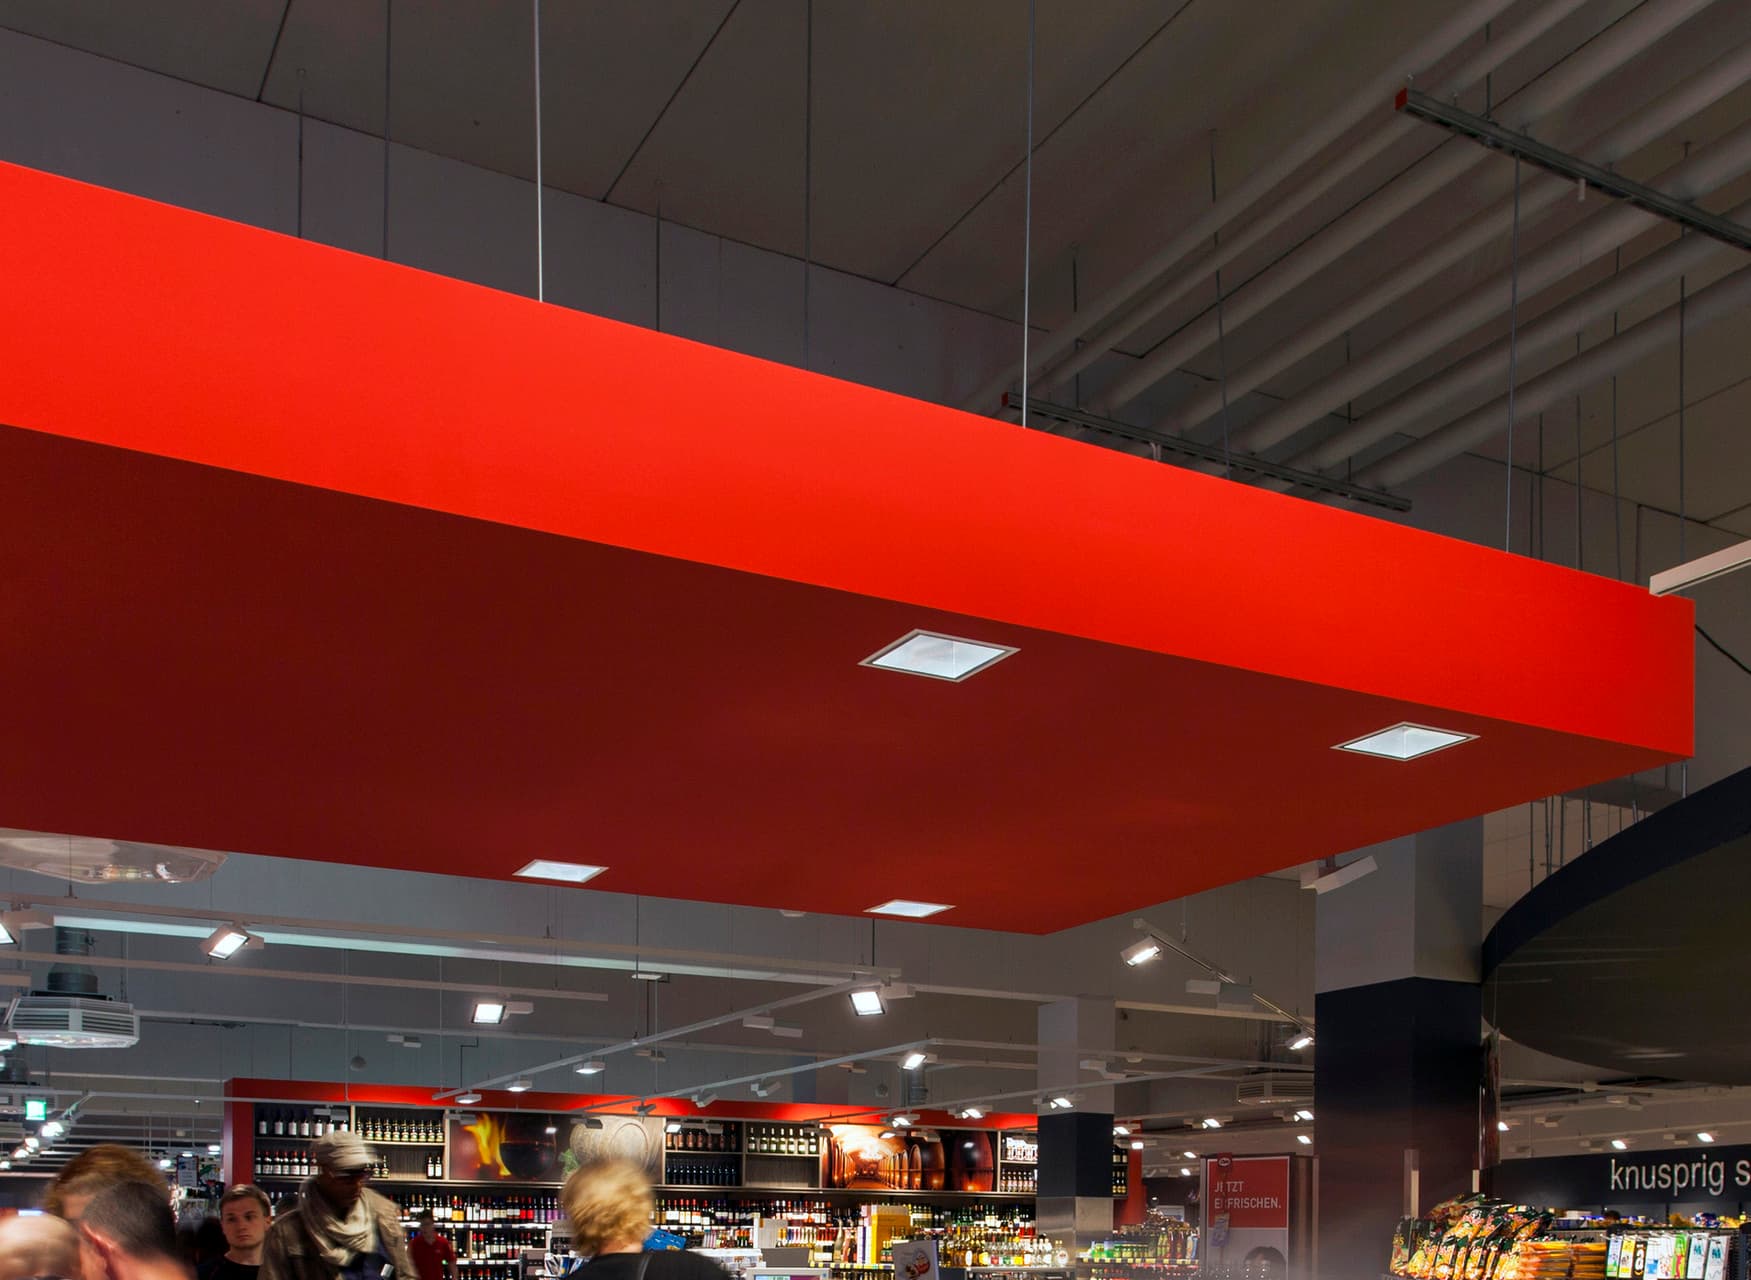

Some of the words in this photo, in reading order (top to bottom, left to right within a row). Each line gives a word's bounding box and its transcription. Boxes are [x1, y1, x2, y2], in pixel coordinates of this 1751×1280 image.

[1611, 1154, 1724, 1196] knusprig
[1735, 1160, 1751, 1186] s
[1214, 1197, 1282, 1209] EFRISCHEN.
